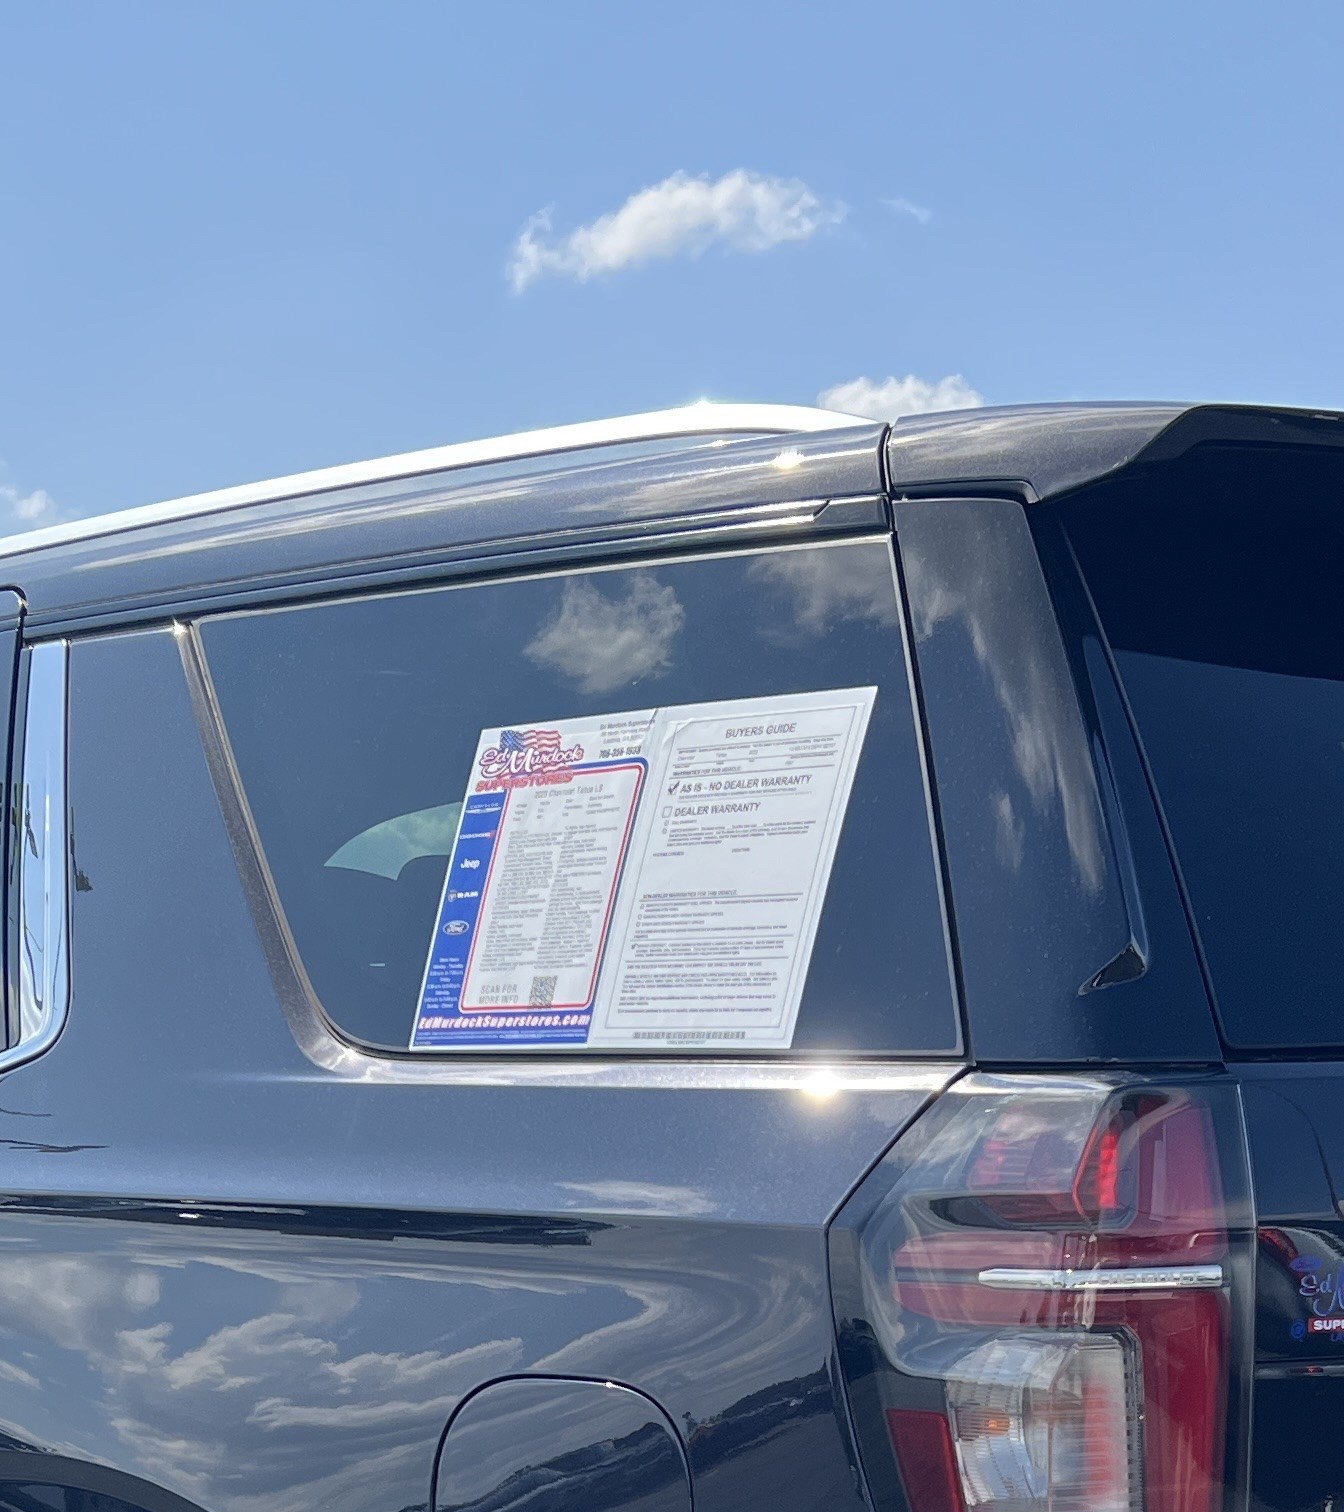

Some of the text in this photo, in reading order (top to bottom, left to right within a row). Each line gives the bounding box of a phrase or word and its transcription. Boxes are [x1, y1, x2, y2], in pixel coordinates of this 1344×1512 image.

[725, 723, 797, 738] BUYERS GUIDE
[479, 744, 584, 778] Ed Murdock
[475, 771, 574, 793] SUPERSTORES
[680, 783, 692, 793] AS
[693, 782, 702, 792] IS
[709, 781, 722, 791] NO
[723, 777, 759, 790] DEALER
[760, 774, 812, 788] WARRANTY
[674, 802, 761, 817] DEALER WARRANTY
[460, 858, 480, 869] Jeep
[457, 891, 478, 899] RAM
[480, 983, 518, 995] SCAN FOR
[478, 994, 519, 1005] MORE INFO
[418, 1013, 591, 1030] EdMurdockSuperstores.com
[1299, 1273, 1333, 1296] Ed
